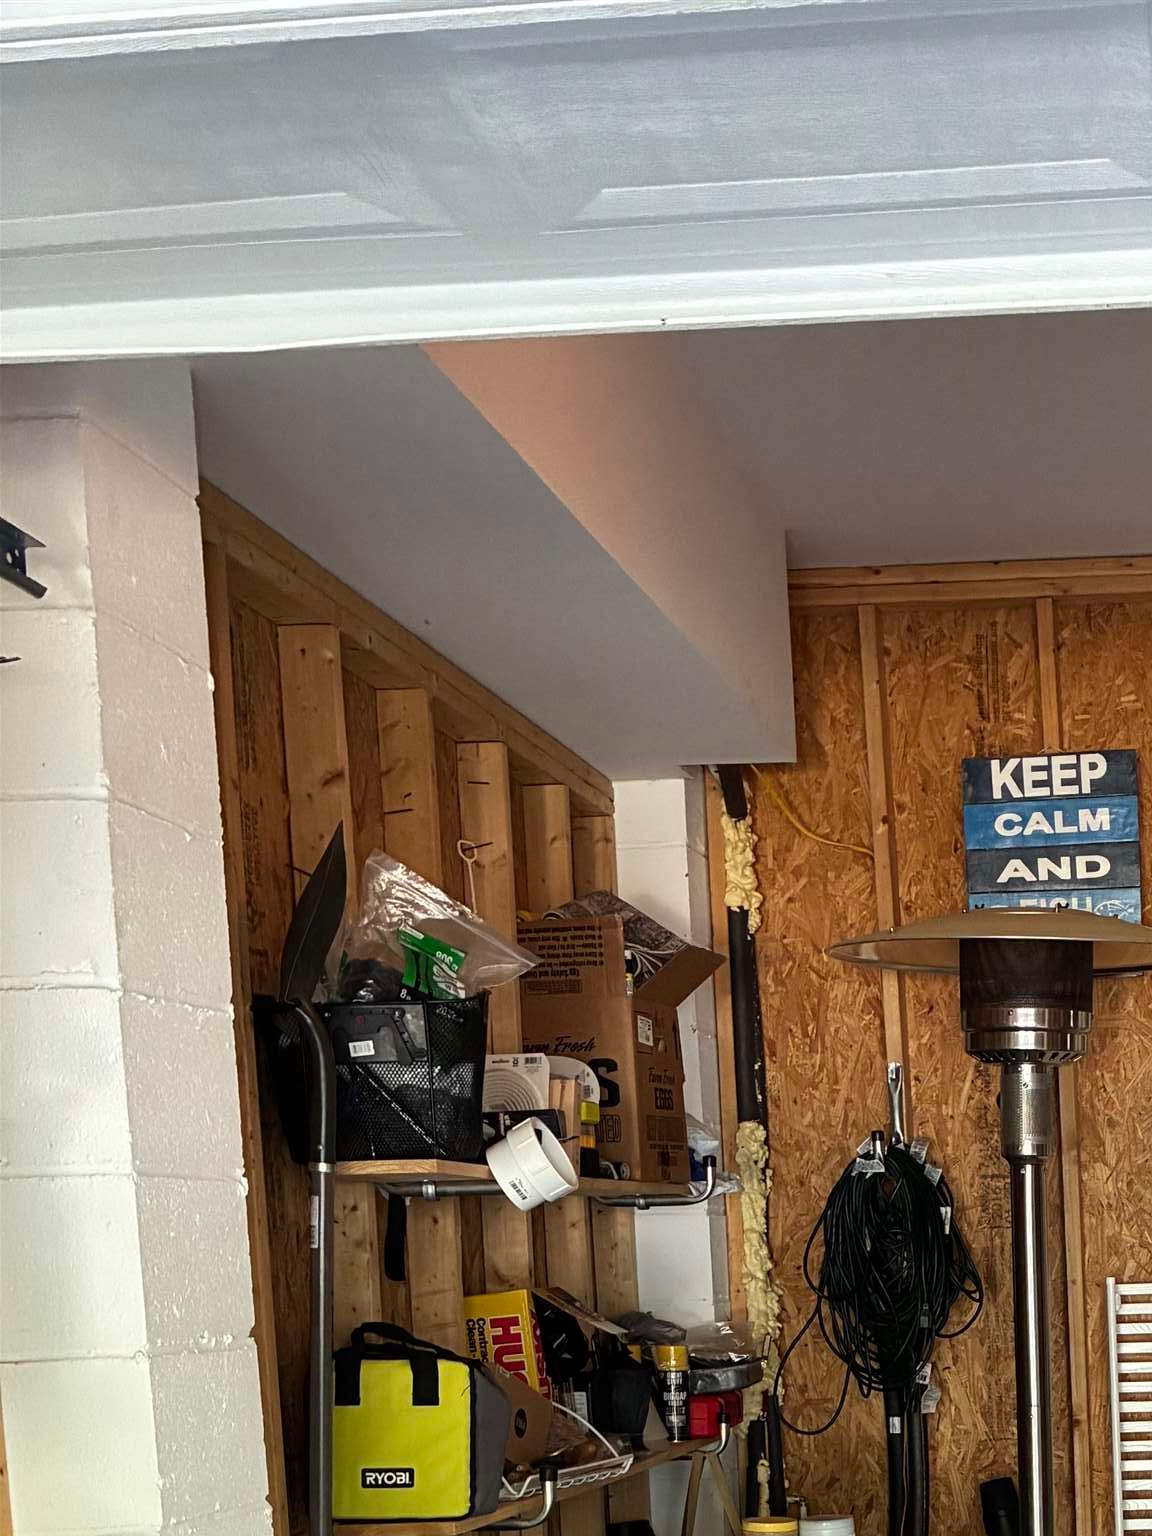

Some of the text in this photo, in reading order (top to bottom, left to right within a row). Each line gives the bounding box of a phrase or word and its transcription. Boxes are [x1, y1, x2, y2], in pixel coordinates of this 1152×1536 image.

[990, 752, 1108, 800] KEEP
[993, 807, 1110, 837] CALM
[996, 854, 1111, 883] AND
[554, 1035, 597, 1053] Fresh
[365, 1471, 410, 1485] RYOBI
